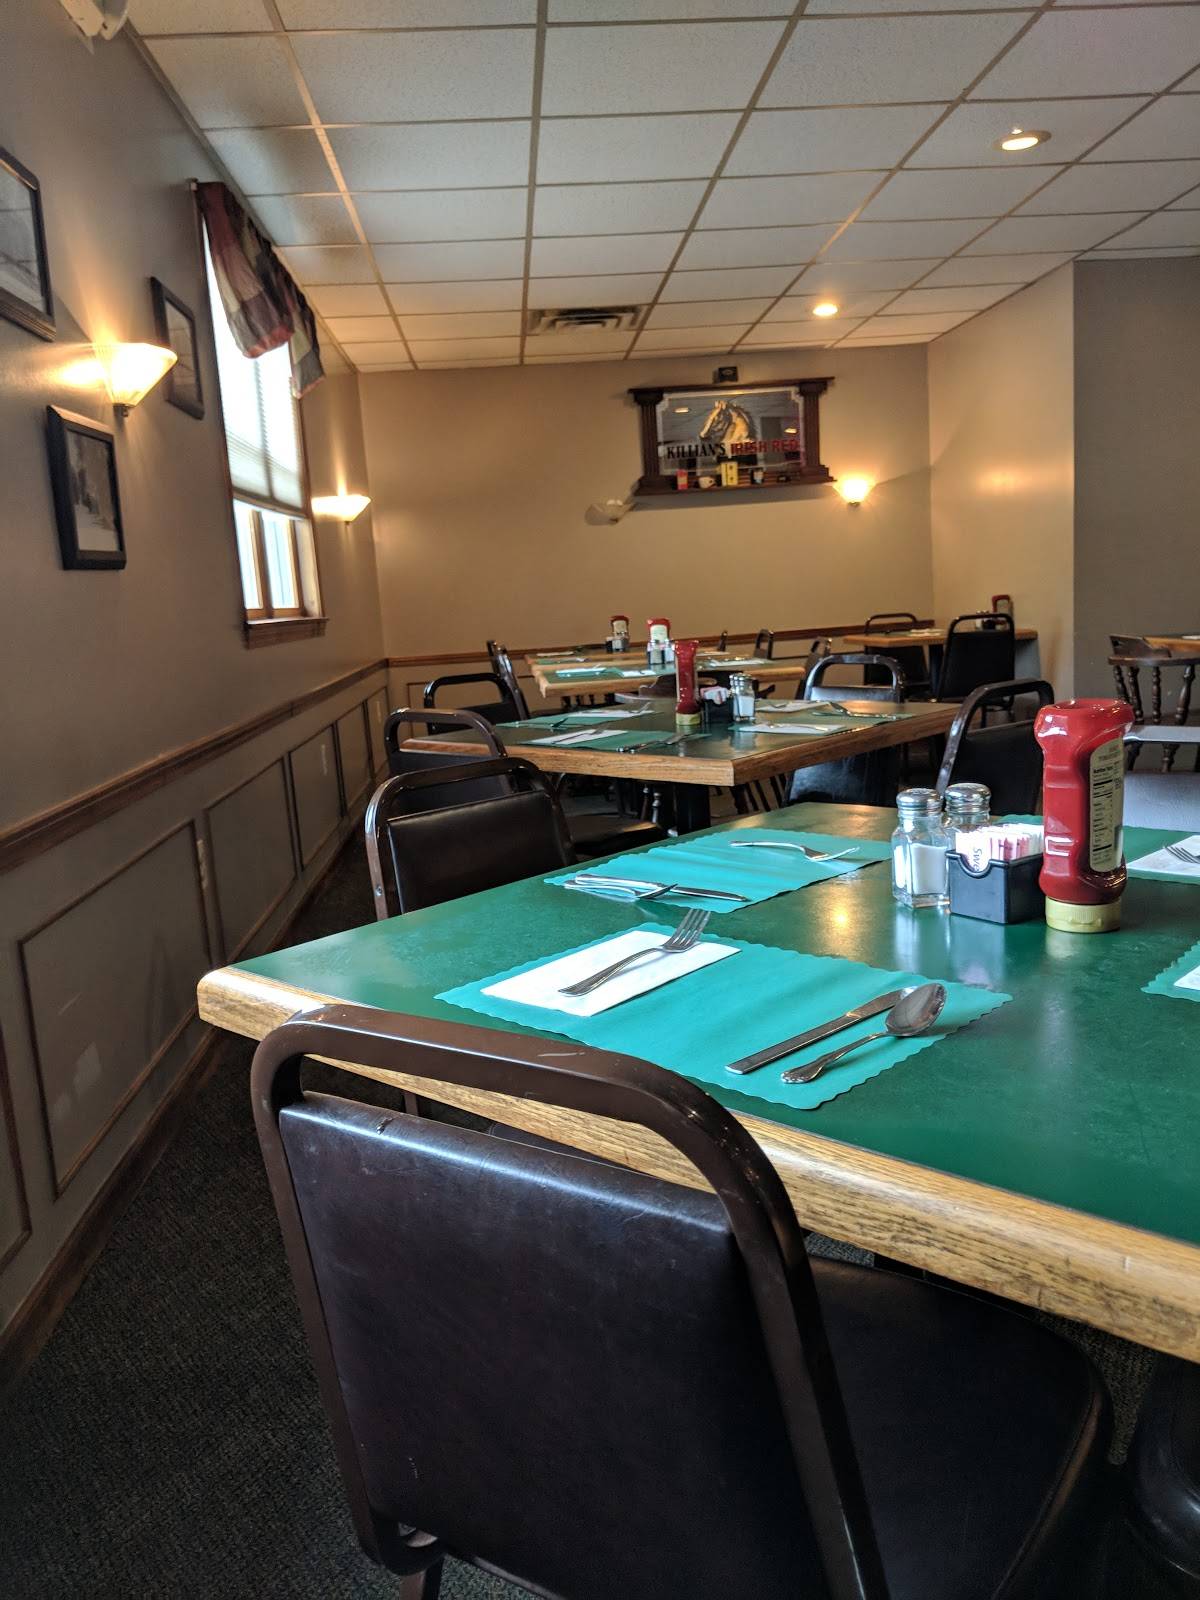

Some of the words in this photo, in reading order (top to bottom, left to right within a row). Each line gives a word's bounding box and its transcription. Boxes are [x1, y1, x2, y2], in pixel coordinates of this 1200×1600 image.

[666, 442, 727, 460] KILLIAN'S
[730, 440, 768, 455] IRISH
[772, 438, 799, 453] RED
[973, 847, 983, 871] Swe
